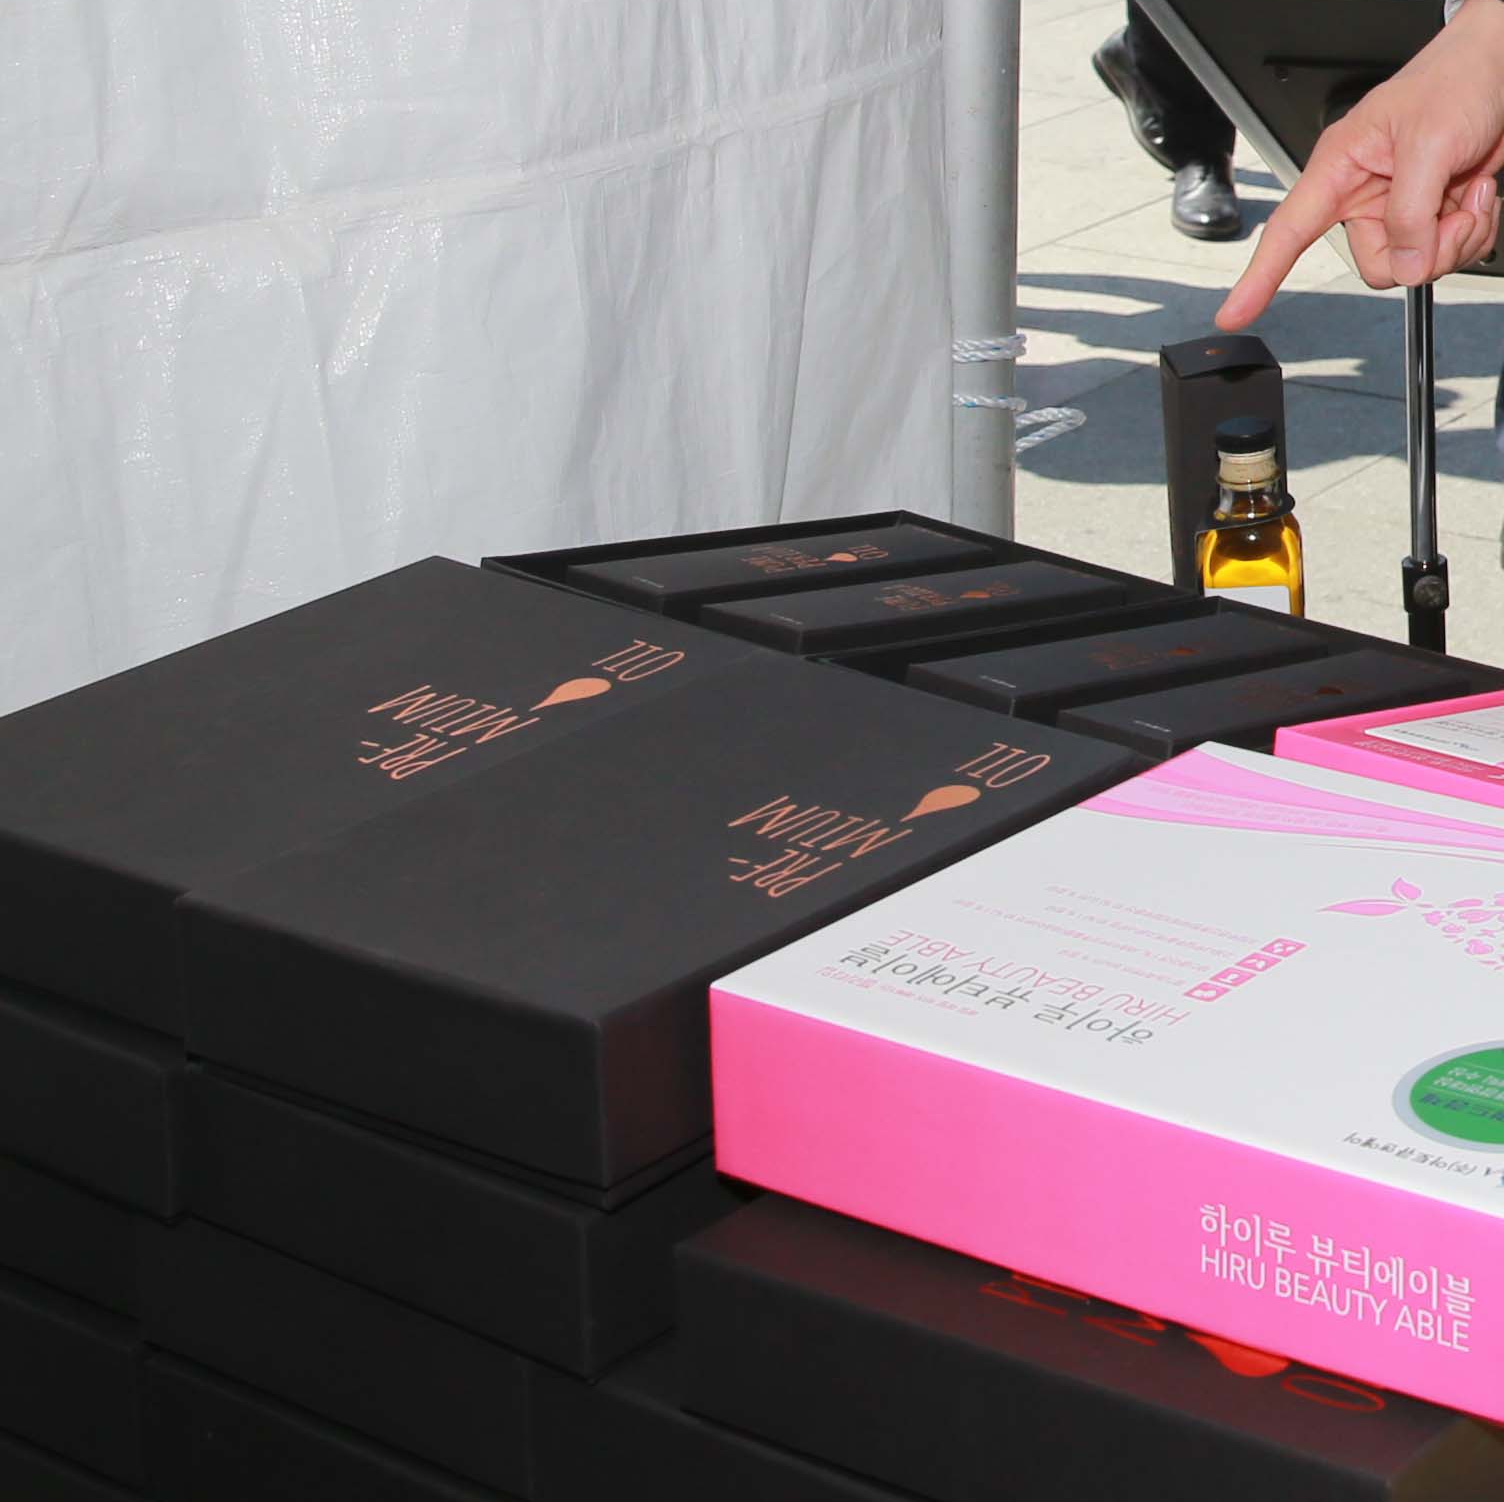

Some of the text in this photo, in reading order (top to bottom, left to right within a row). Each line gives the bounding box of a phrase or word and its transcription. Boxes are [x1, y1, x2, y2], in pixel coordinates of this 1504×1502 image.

[591, 639, 685, 682] OIL
[367, 684, 540, 744] MIUM
[954, 742, 1051, 788] OIL
[727, 795, 912, 858] MIUM
[887, 930, 972, 964] ABLE
[841, 943, 1031, 1010] 뷰티에이블
[963, 954, 1105, 1002] BEAUTY
[1034, 1003, 1153, 1047] 하이루
[1097, 991, 1191, 1026] HIRU
[1200, 1203, 1476, 1320] 하이루 뷰티에이블
[1200, 1244, 1471, 1352] HIRU BEAUTY ABLE
